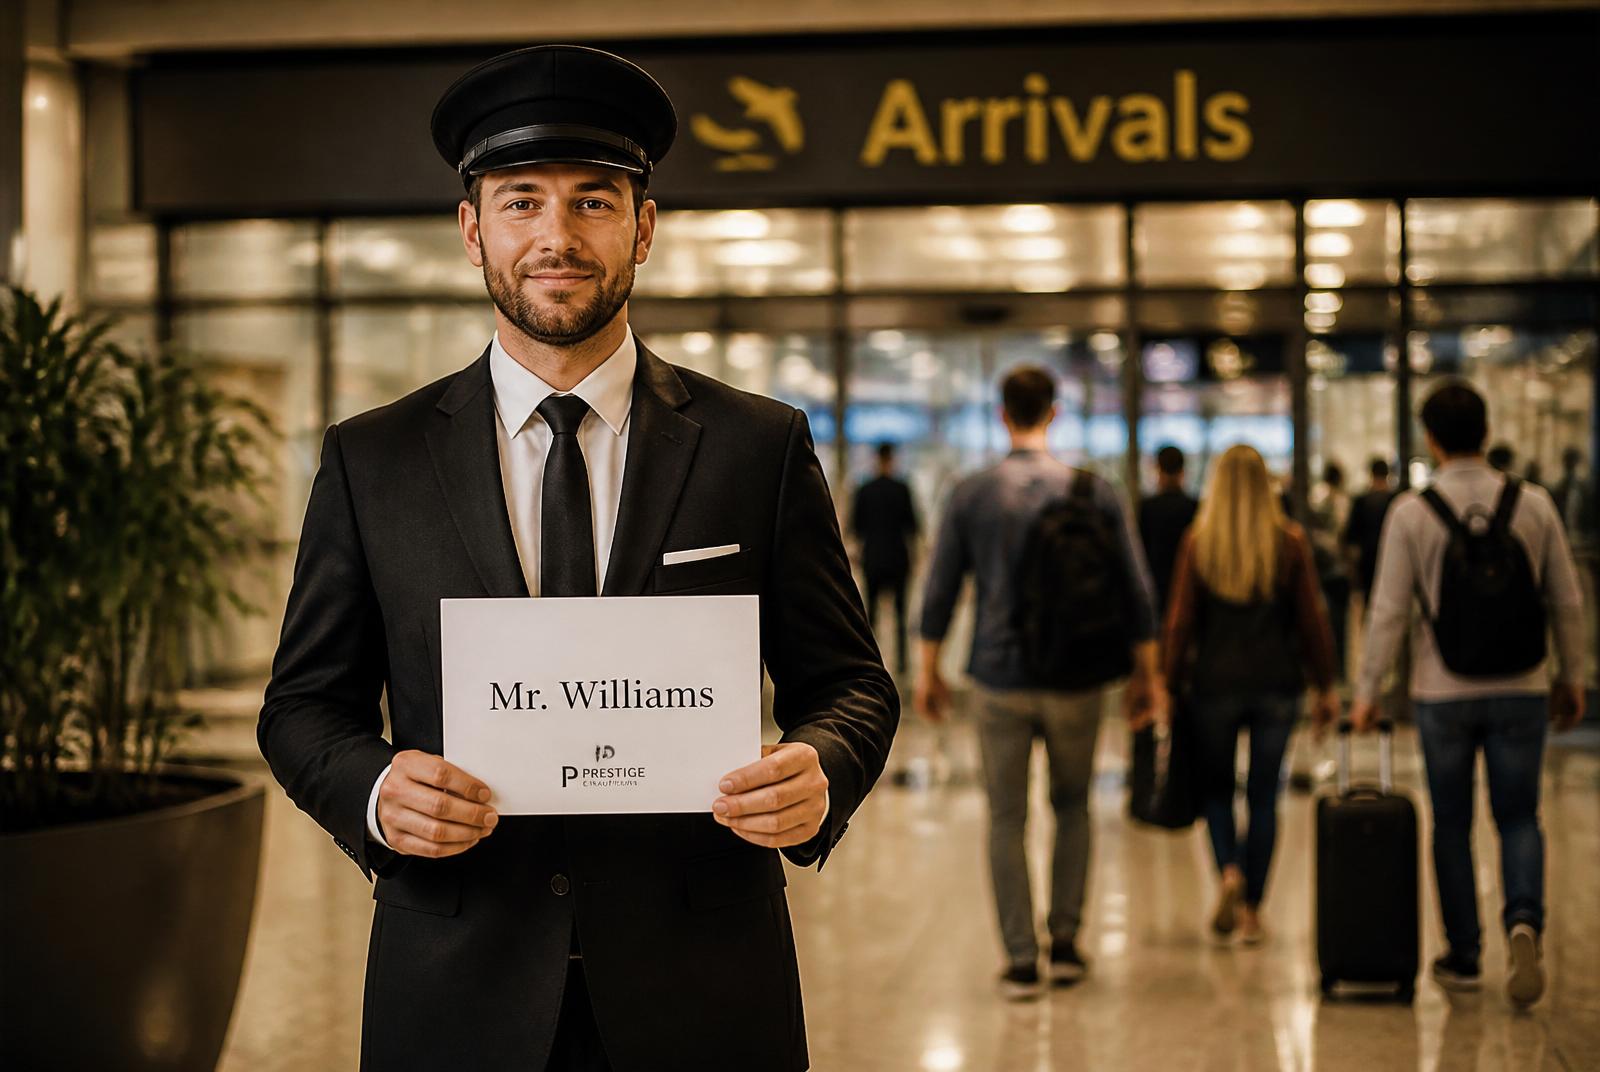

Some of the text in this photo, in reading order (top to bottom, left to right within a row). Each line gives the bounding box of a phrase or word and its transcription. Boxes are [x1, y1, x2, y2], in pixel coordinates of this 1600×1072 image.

[861, 69, 1253, 164] Arrivals
[489, 679, 714, 711] Mr. Williams
[582, 767, 646, 779] PRESTIGE
